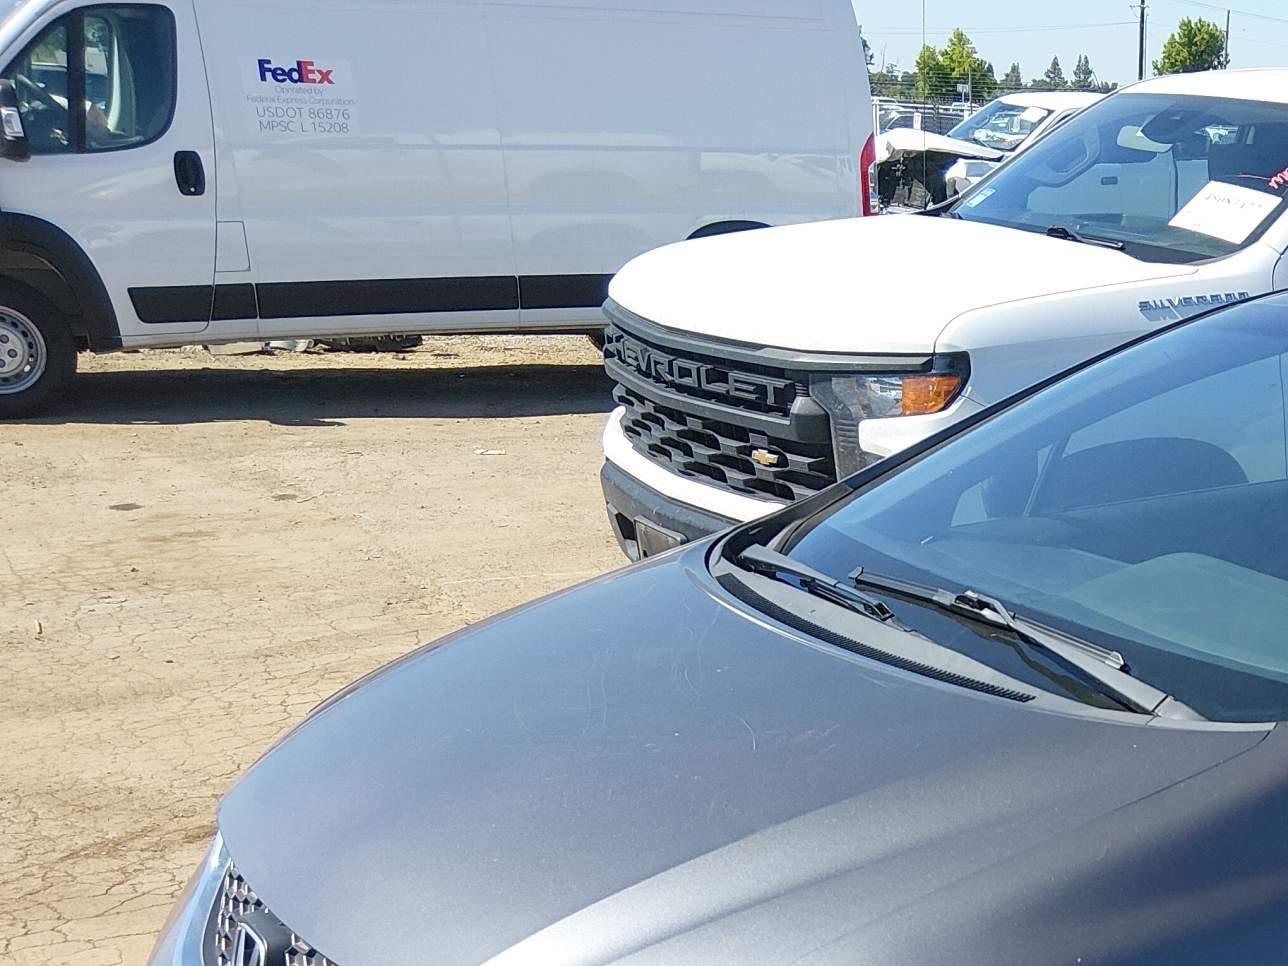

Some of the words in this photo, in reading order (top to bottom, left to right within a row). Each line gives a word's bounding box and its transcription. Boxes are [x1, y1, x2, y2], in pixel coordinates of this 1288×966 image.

[257, 59, 336, 85] FedEx
[256, 106, 305, 119] USDOT
[308, 108, 351, 121] 86876
[259, 120, 297, 133] MPSC
[301, 121, 309, 133] L
[311, 122, 350, 134] 15208
